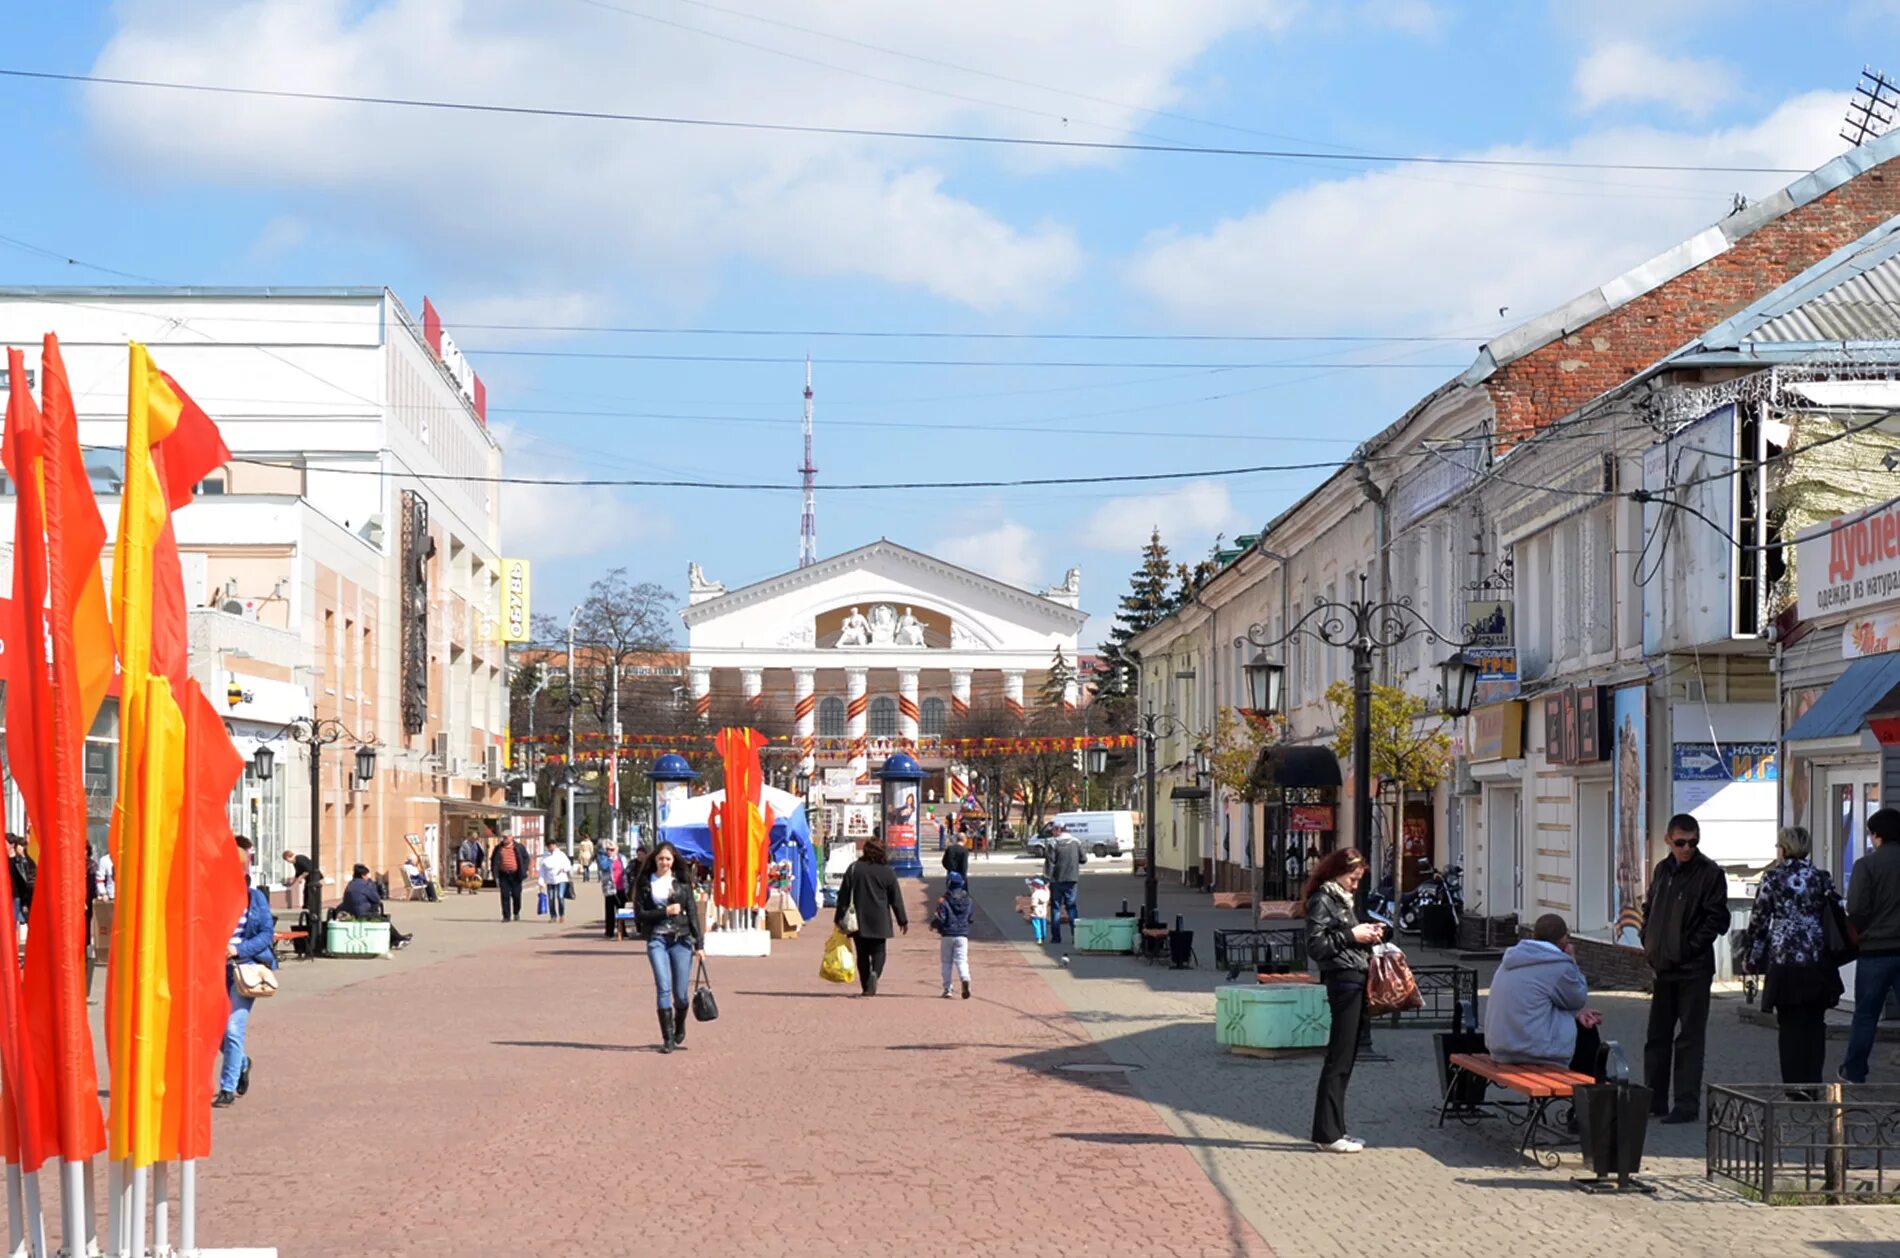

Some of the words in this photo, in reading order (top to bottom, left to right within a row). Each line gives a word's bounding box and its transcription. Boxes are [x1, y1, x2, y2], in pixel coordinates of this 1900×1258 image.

[510, 562, 522, 637] ОБУВЬ
[1817, 585, 1850, 610] одежда
[1853, 579, 1864, 600] из
